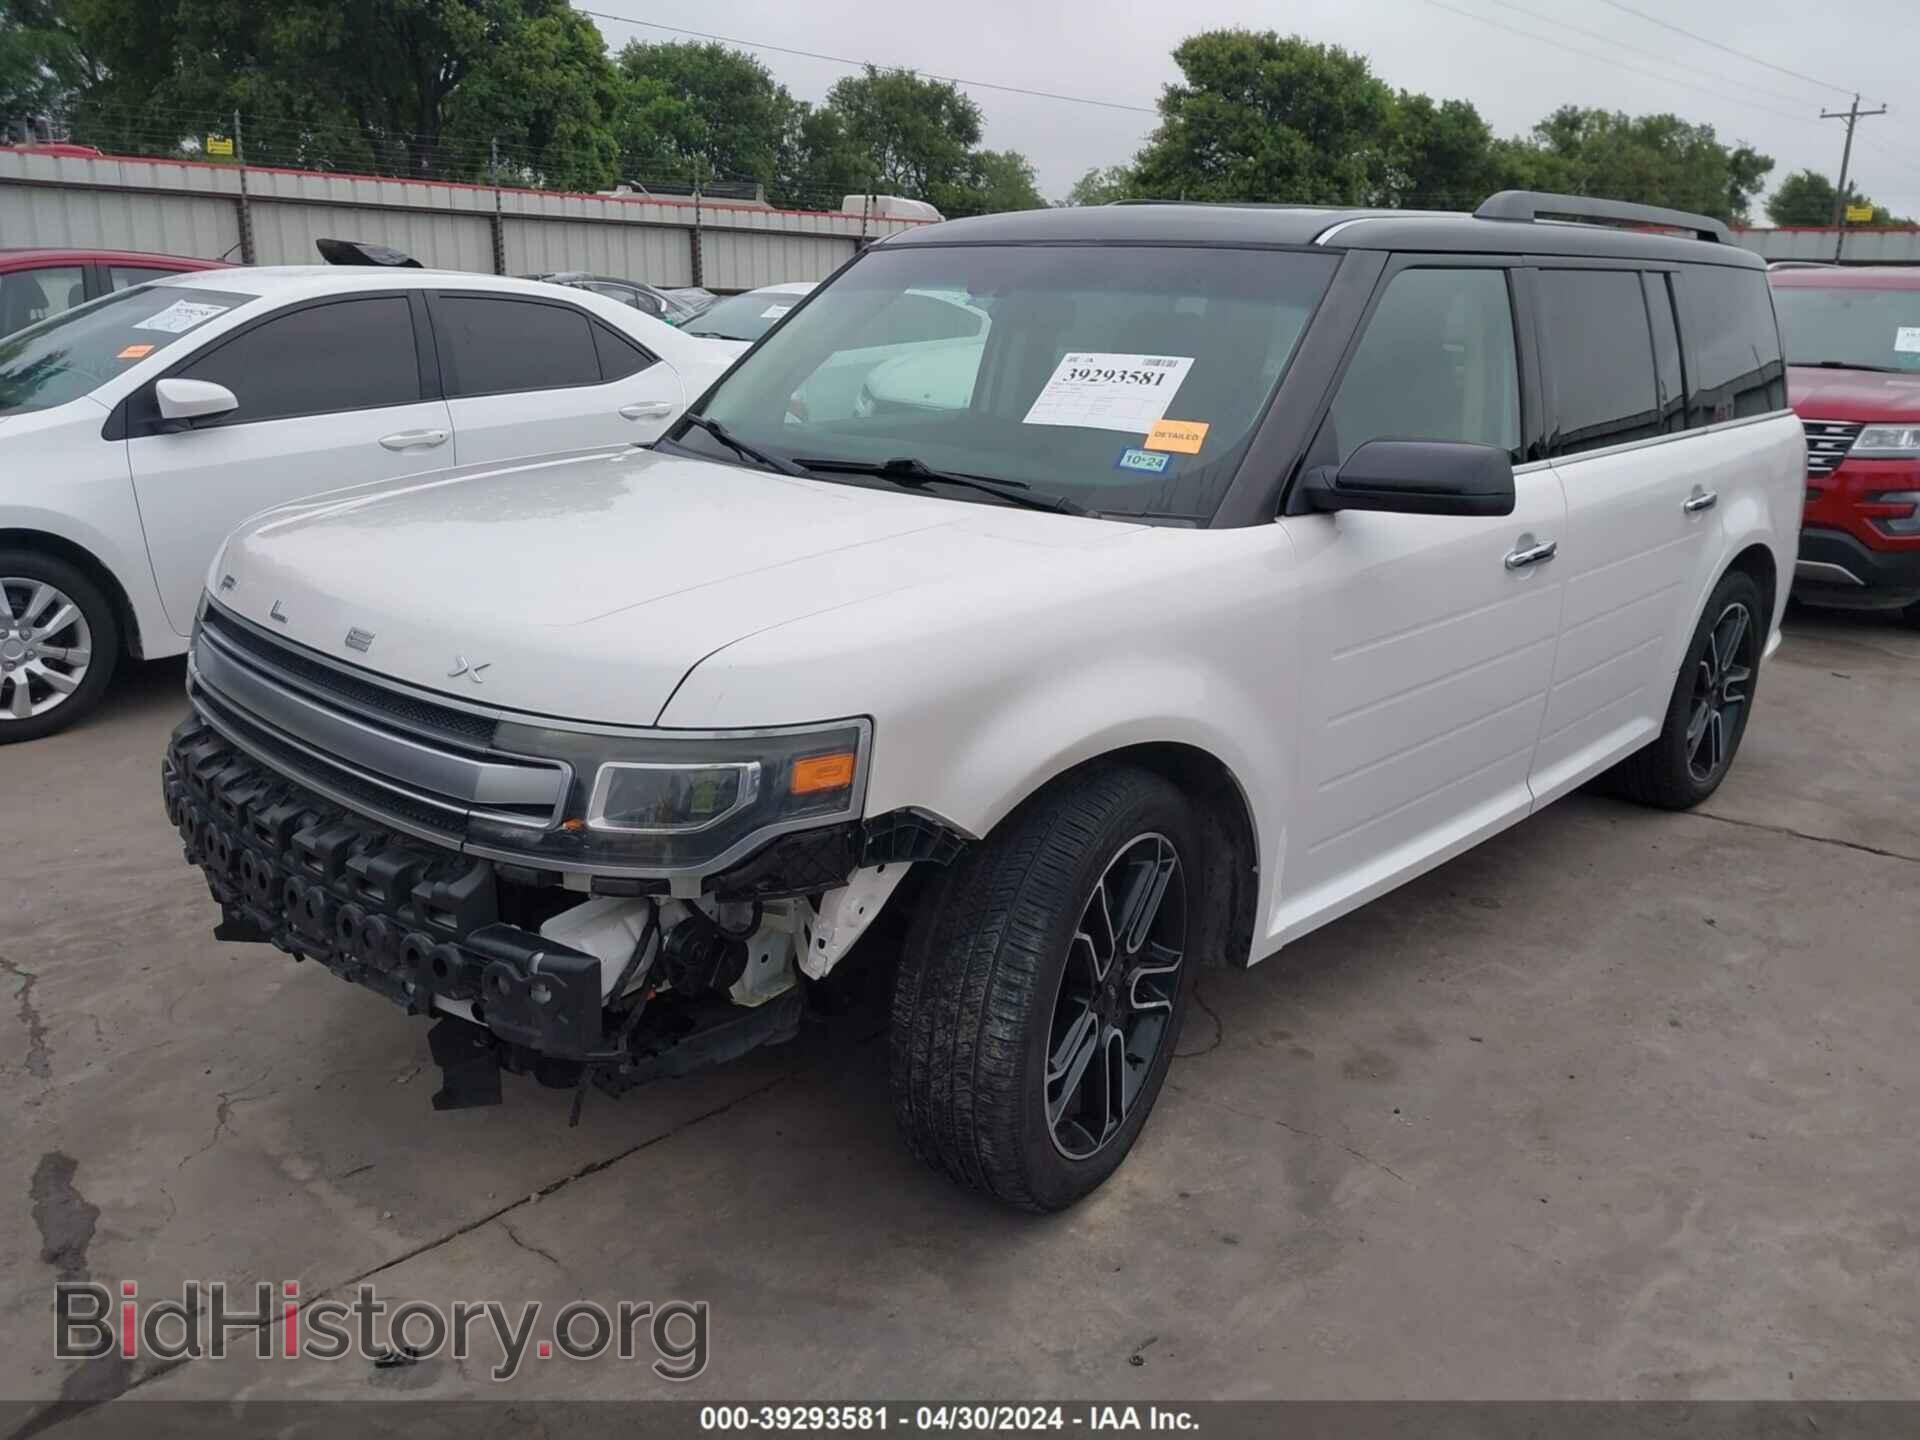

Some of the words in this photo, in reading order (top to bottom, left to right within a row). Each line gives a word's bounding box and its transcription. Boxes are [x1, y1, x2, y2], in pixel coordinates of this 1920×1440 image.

[1062, 368, 1166, 386] 39293581
[1154, 431, 1199, 441] DETAILED
[220, 574, 491, 684] FLEX
